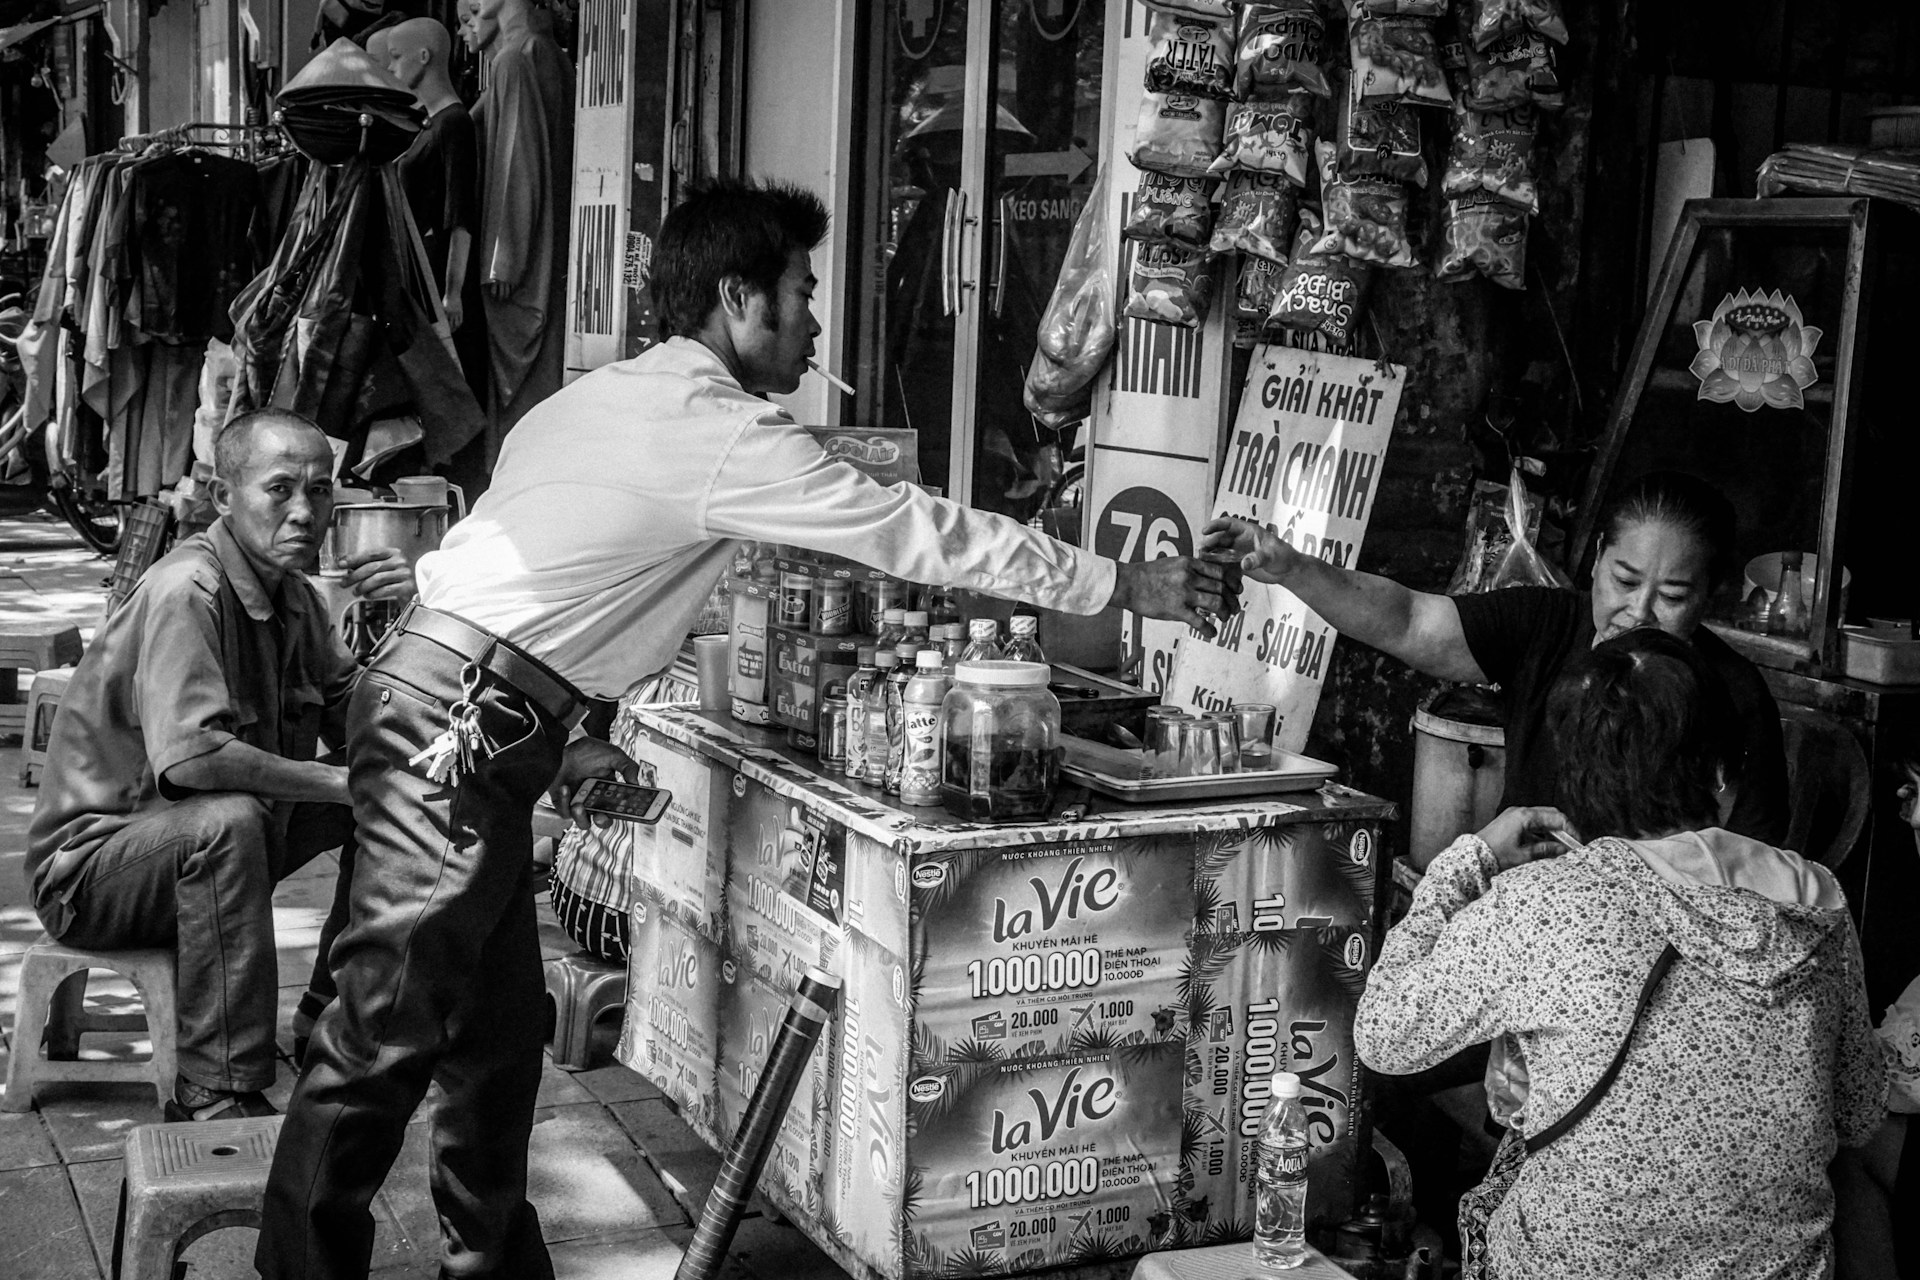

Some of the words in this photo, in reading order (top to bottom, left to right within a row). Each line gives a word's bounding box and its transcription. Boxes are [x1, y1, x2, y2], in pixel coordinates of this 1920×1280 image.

[1165, 40, 1216, 74] TATER
[1282, 289, 1353, 326] Snack
[1321, 319, 1347, 338] Oishi
[1228, 420, 1280, 500] TRÀ
[1281, 441, 1378, 521] CHANH
[1110, 510, 1181, 564] 76
[778, 650, 811, 677] Extra
[1295, 626, 1329, 681] ĐÁ
[776, 694, 809, 721] Extra
[747, 873, 797, 935] 1.000.000
[967, 948, 1101, 998] 1.000.000
[648, 993, 688, 1049] 1.000.000
[1011, 1008, 1058, 1029] 20.000
[1099, 1000, 1134, 1019] 1.000
[827, 1028, 837, 1078] 20.000
[839, 998, 861, 1139] 1.000.000
[1213, 1046, 1230, 1096] 20.000
[823, 1120, 833, 1158] 1.000
[1208, 1138, 1225, 1176] 1.000
[965, 1156, 1099, 1208] 1.000.000
[1009, 1216, 1056, 1238] 20.000
[1096, 1205, 1130, 1225] 1.000
